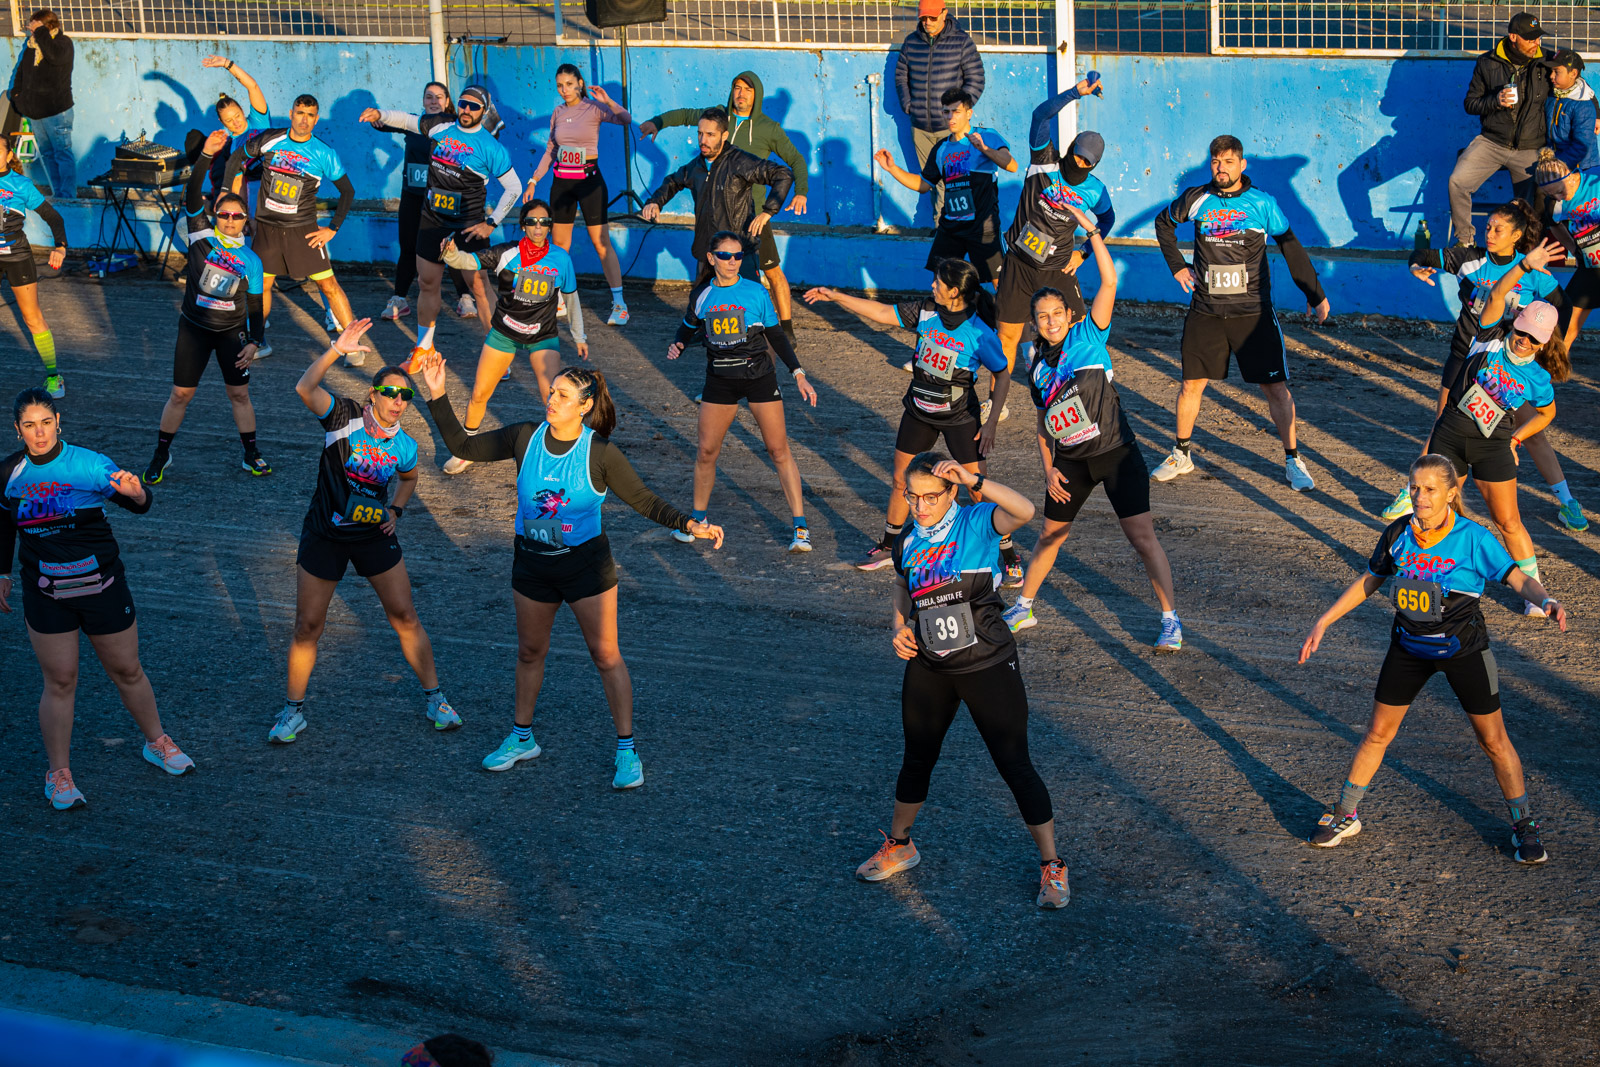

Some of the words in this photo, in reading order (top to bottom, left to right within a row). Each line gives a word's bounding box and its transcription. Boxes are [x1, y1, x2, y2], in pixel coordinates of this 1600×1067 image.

[562, 150, 580, 164] 208
[274, 180, 298, 198] 756
[434, 193, 454, 210] 732
[948, 196, 968, 212] 113
[1024, 231, 1046, 255] 721
[210, 274, 228, 292] 67
[524, 278, 548, 296] 619
[1216, 272, 1240, 288] 130
[713, 317, 739, 335] 642
[923, 347, 949, 371] 245
[1050, 406, 1080, 432] 213
[1466, 396, 1495, 424] 259
[352, 504, 383, 524] 635
[42, 562, 77, 570] Prevención
[77, 558, 94, 568] Salud
[936, 593, 955, 603] SANTA
[1397, 588, 1430, 613] 650
[936, 616, 958, 641] 39
